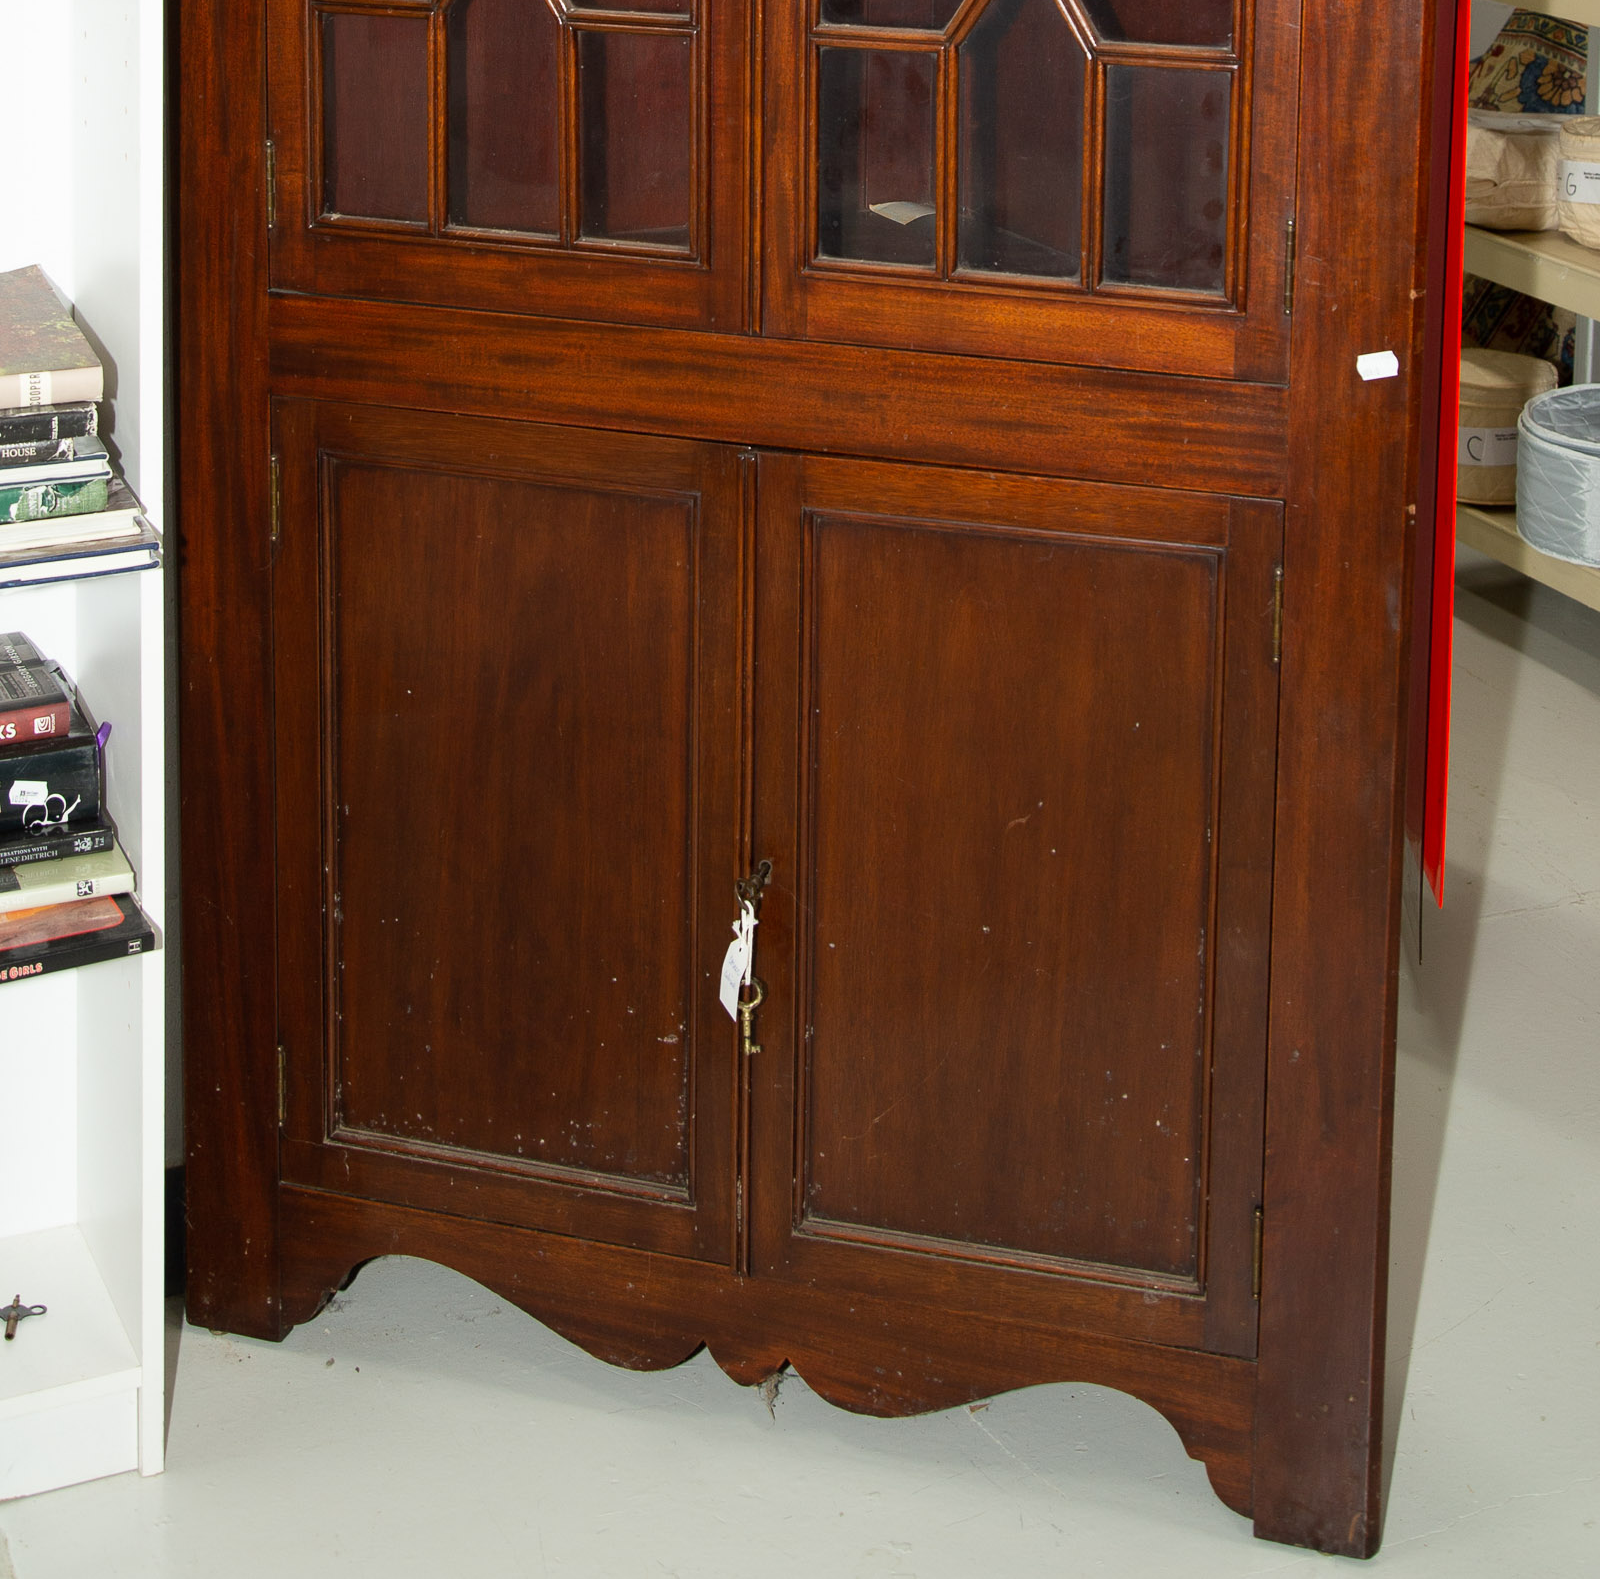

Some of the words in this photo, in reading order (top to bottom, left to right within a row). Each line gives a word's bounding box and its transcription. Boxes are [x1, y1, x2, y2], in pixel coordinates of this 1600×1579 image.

[1, 447, 37, 459] HOUSE
[31, 845, 48, 853] WITH
[21, 850, 58, 862] DIETRICH
[9, 962, 43, 980] GIRLS
